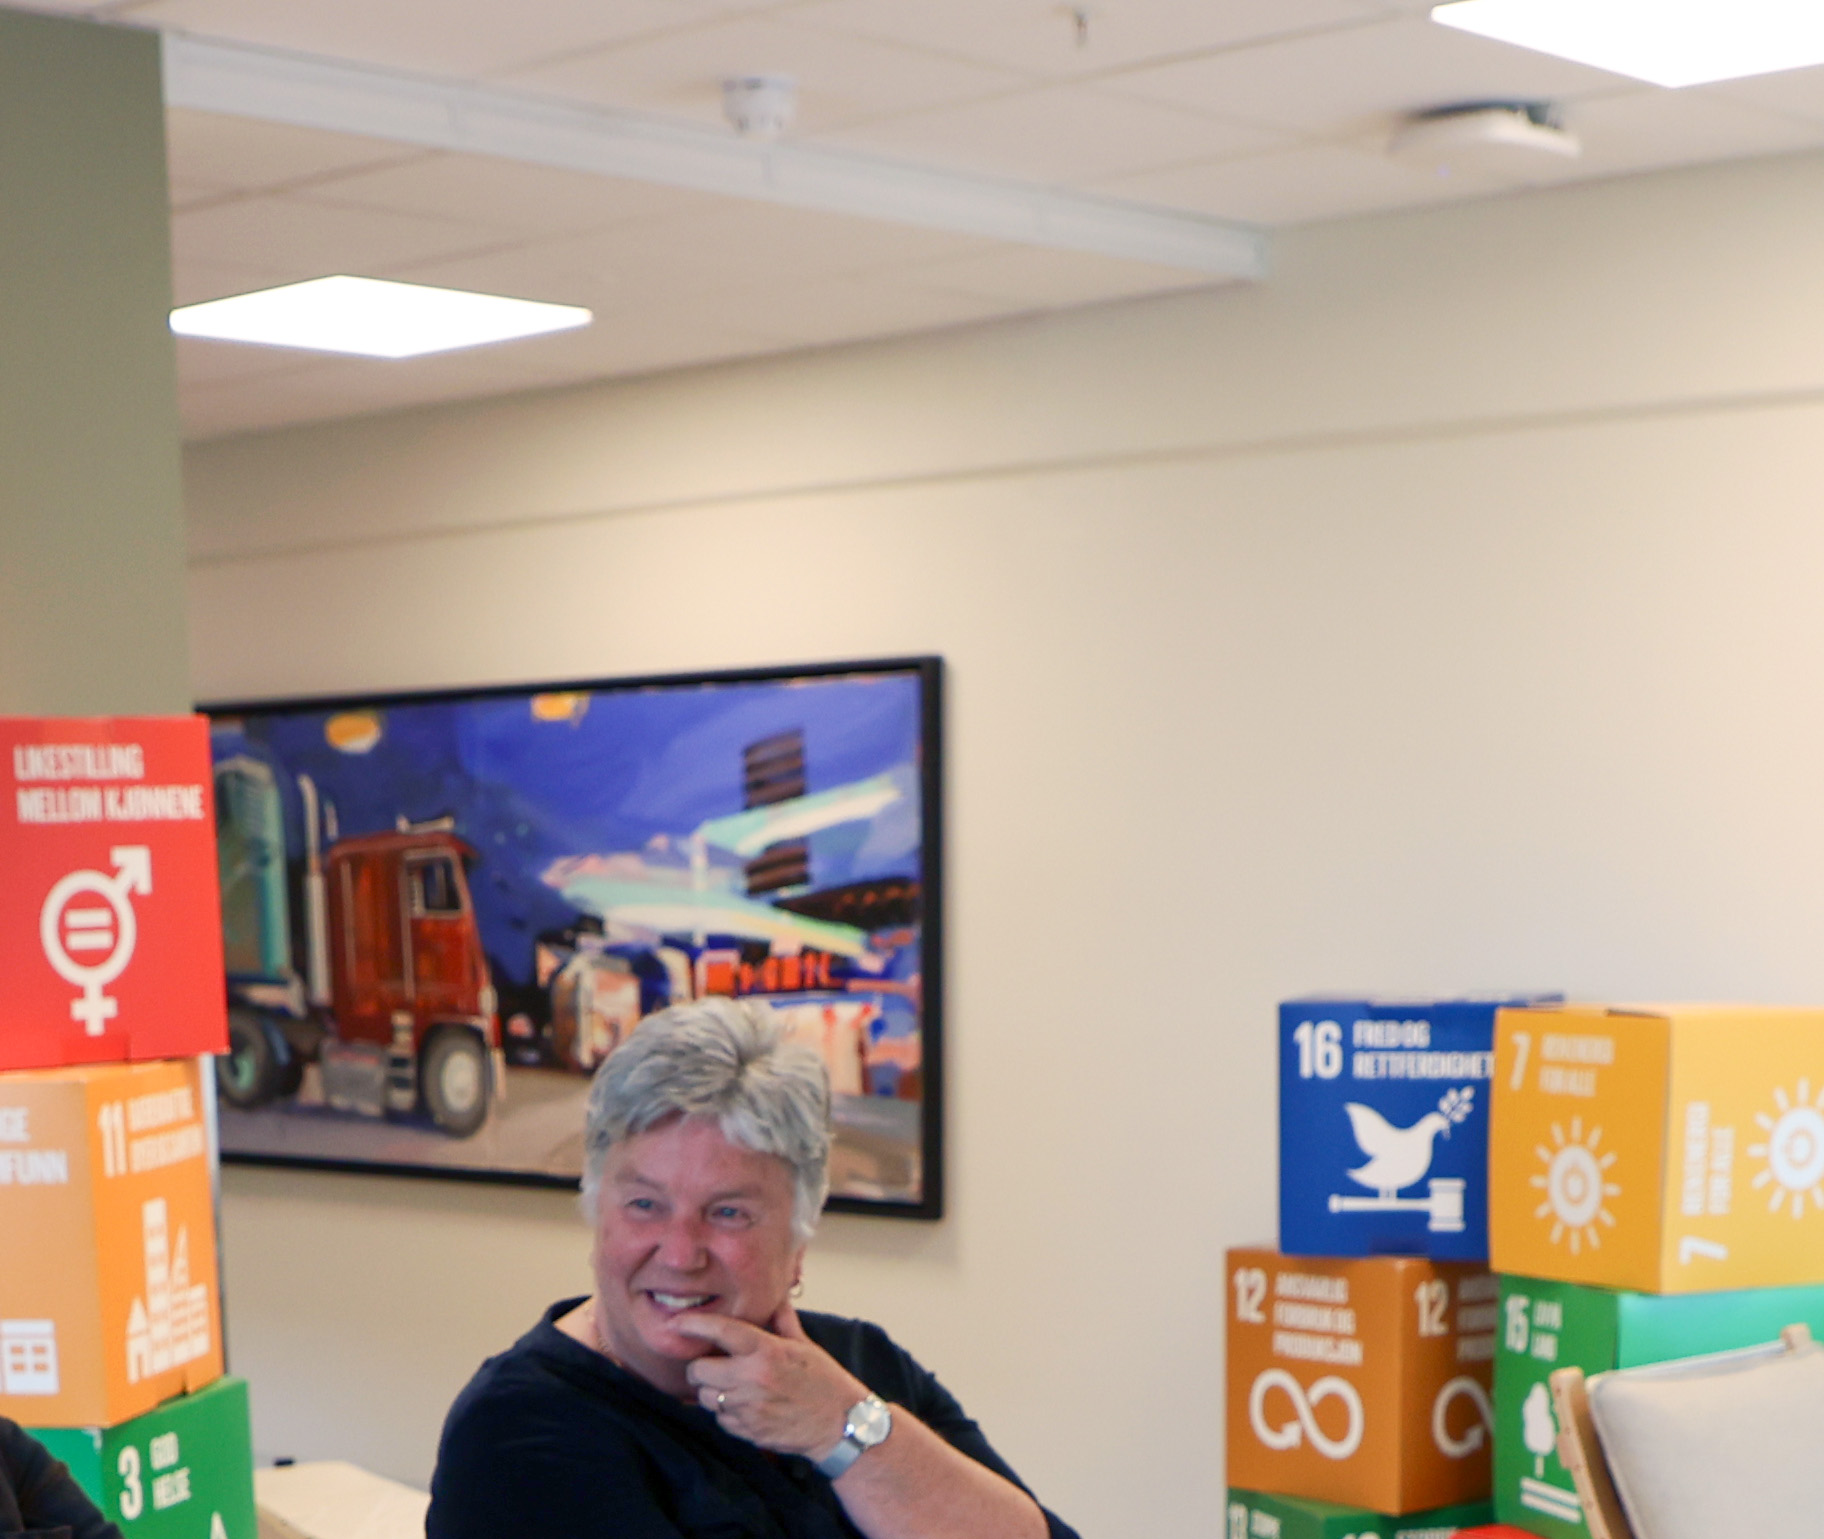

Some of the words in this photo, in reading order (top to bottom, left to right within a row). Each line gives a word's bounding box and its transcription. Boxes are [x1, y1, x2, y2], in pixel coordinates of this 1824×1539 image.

[13, 743, 145, 781] LIKESTILLING
[16, 786, 103, 823] MELLOM
[1293, 1020, 1344, 1079] 16
[1352, 1020, 1401, 1048] FRED
[1401, 1020, 1431, 1048] OG
[1510, 1030, 1532, 1092] 7
[97, 1100, 128, 1178] 11
[1678, 1234, 1729, 1266] 7
[1234, 1266, 1267, 1323] 12
[1414, 1278, 1449, 1338] 12
[1505, 1294, 1530, 1353] 15
[117, 1445, 143, 1520] 3
